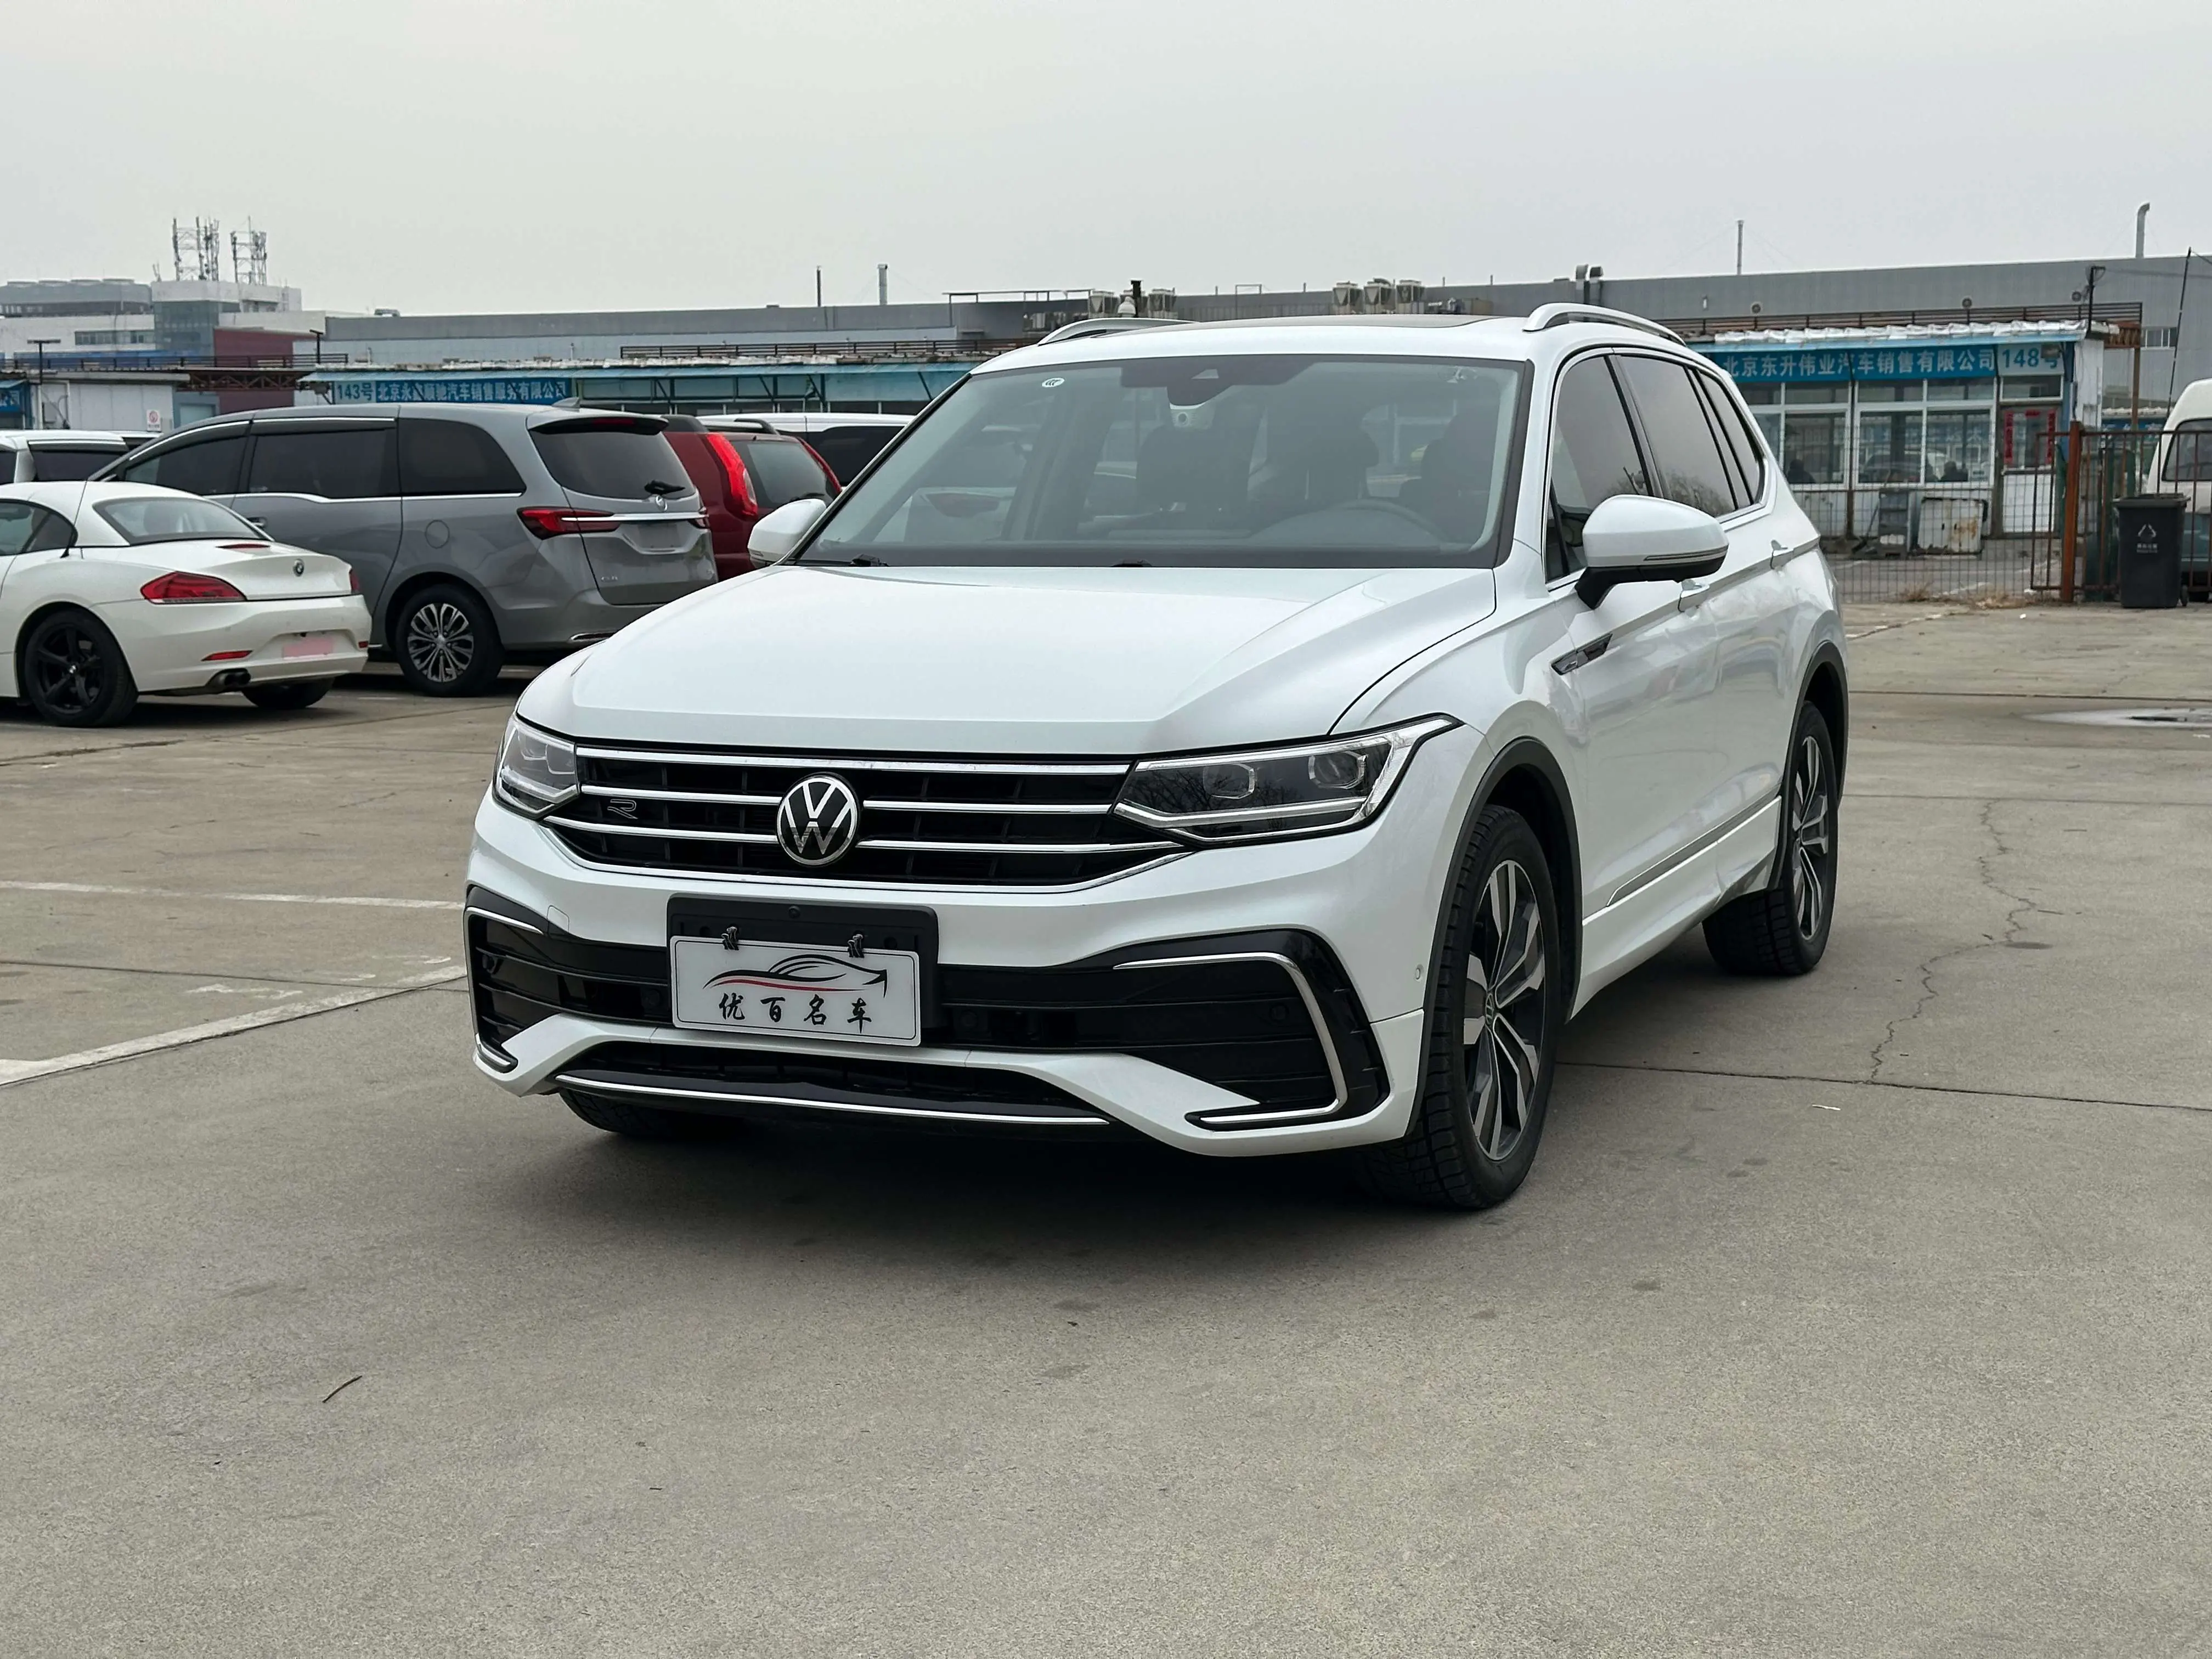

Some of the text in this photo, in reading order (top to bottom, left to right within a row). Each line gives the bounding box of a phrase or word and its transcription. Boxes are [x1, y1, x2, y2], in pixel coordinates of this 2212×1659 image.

[1723, 349, 1995, 377] 北京东升伟业汽车销售有限公司
[337, 382, 373, 401] 143号
[607, 798, 639, 820] R
[781, 778, 855, 859] VW
[718, 992, 872, 1034] 优百名车
